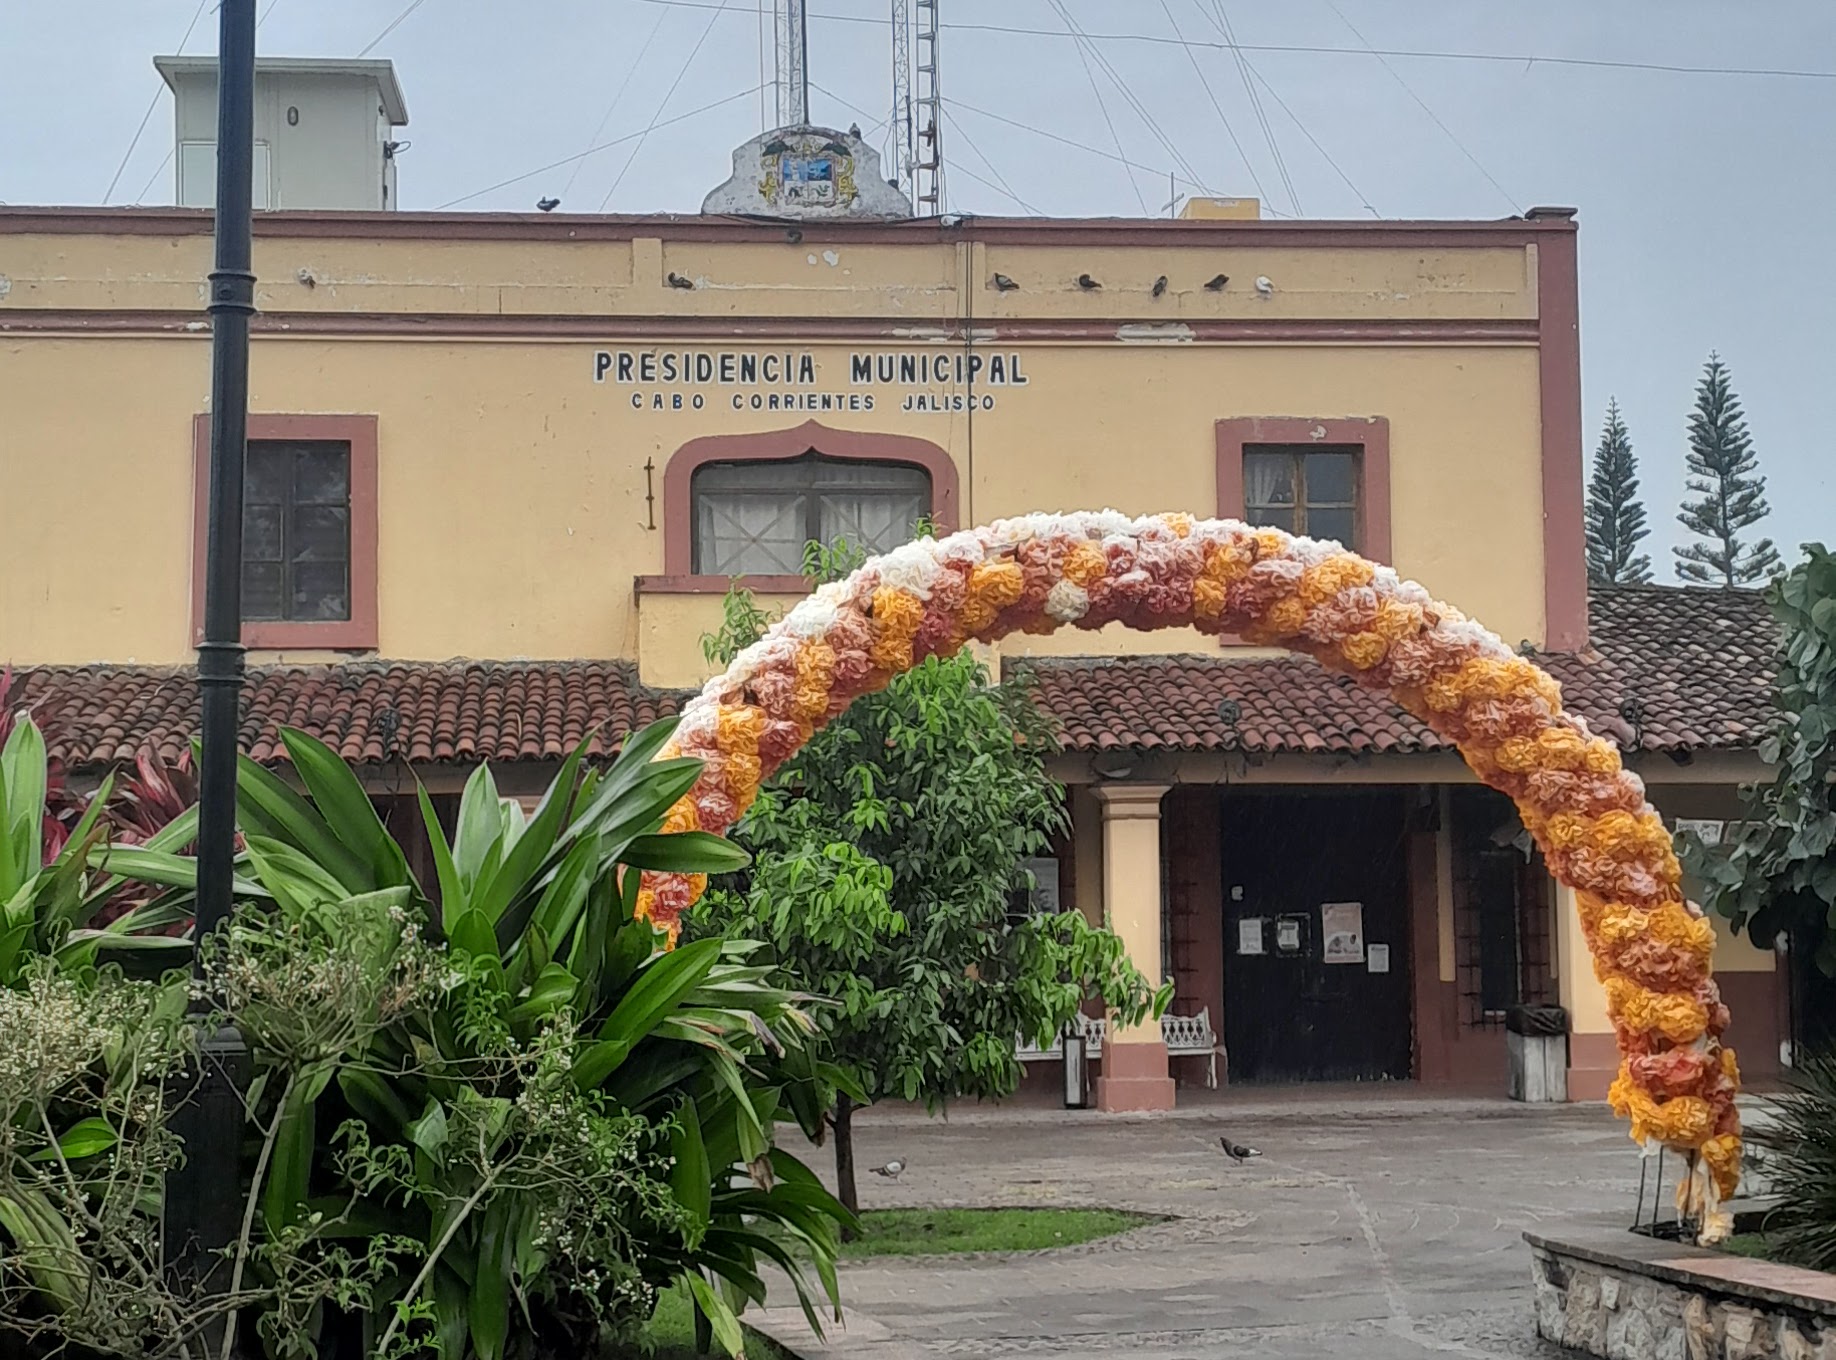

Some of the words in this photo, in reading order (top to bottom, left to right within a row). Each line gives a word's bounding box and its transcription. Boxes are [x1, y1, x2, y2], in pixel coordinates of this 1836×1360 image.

[595, 351, 815, 383] PRESIDENCIA
[851, 353, 1028, 383] MUNICIPAL
[630, 393, 705, 410] CABO
[731, 393, 875, 411] CORRIENTES
[901, 394, 995, 411] JALISCO
